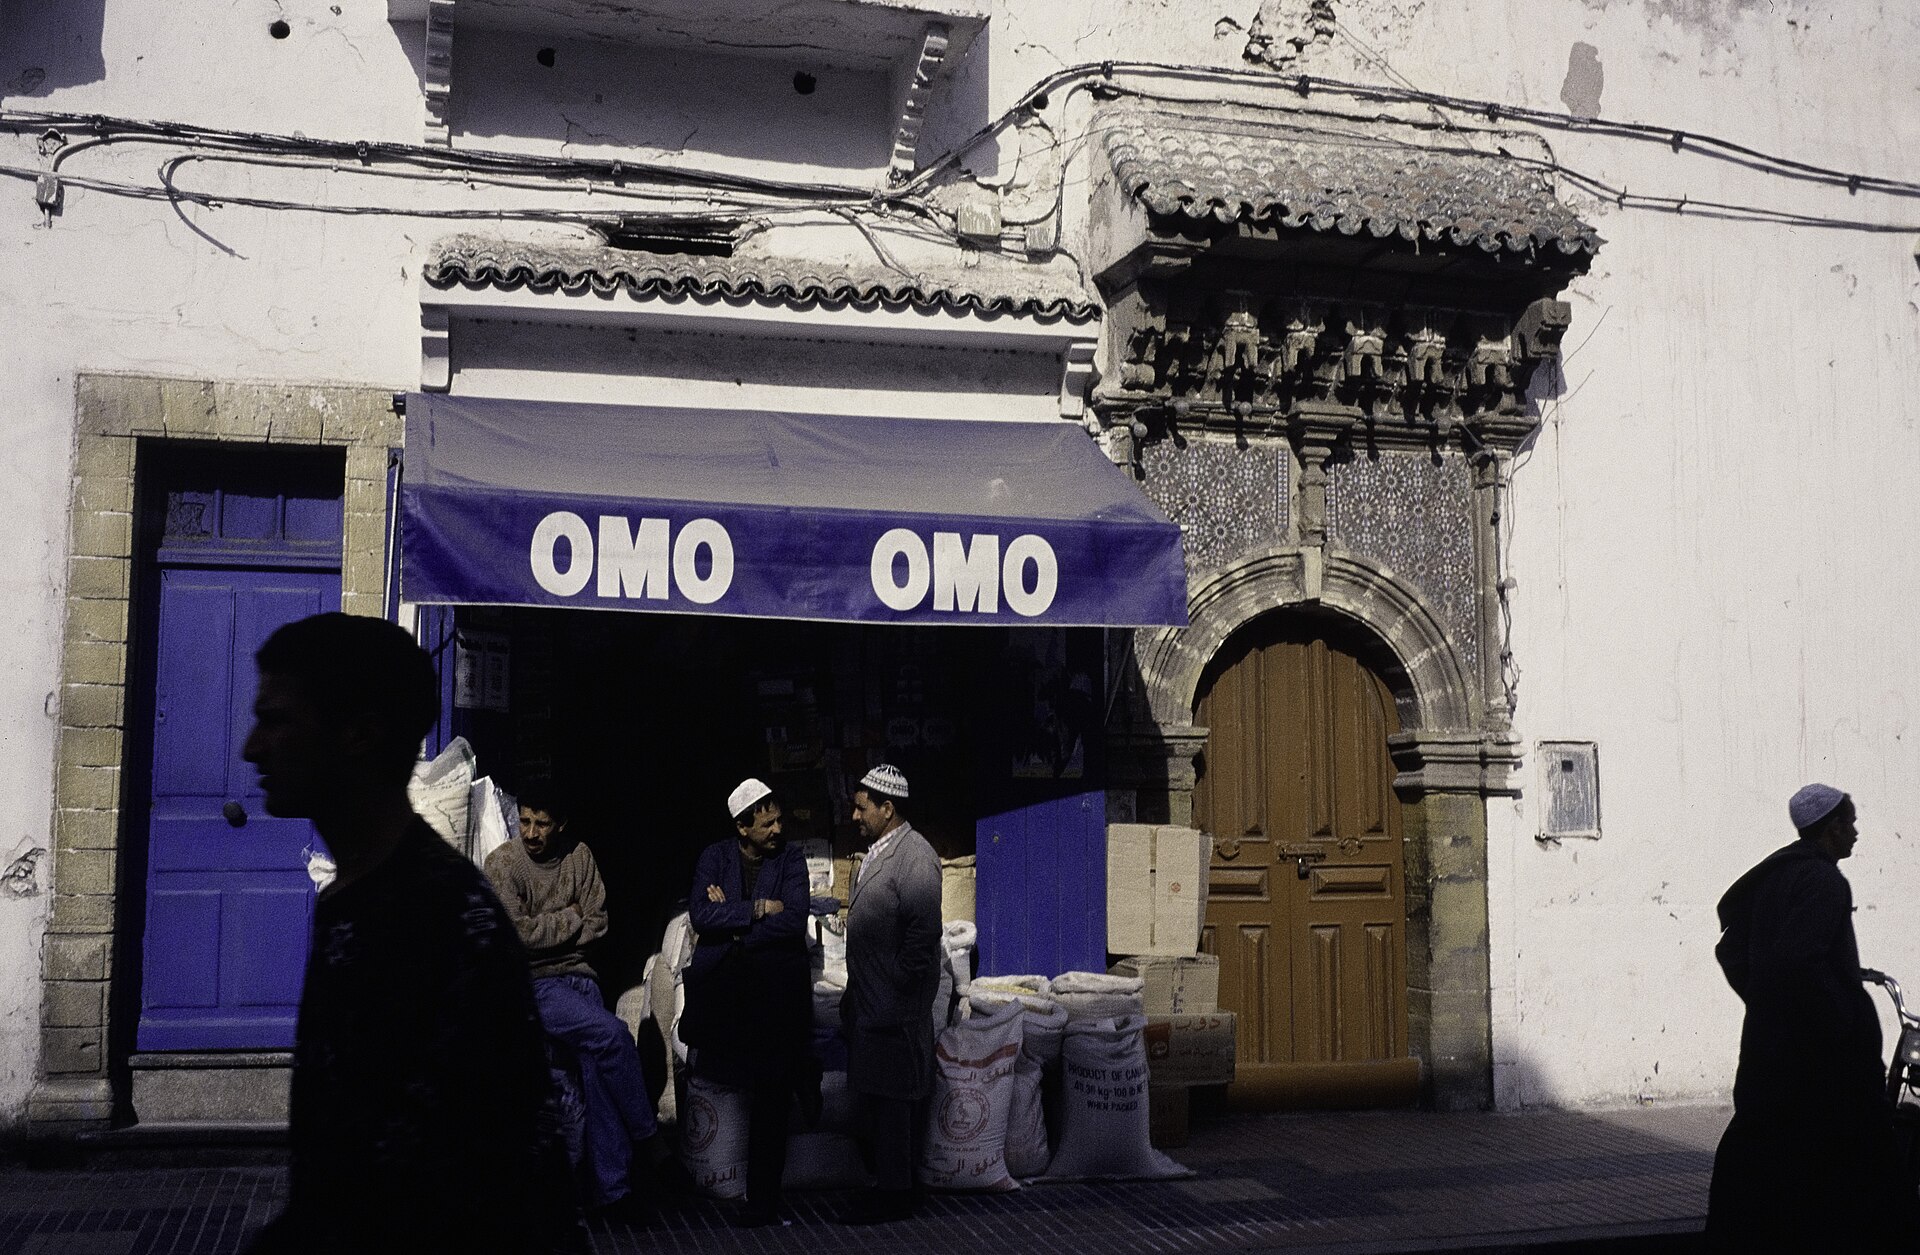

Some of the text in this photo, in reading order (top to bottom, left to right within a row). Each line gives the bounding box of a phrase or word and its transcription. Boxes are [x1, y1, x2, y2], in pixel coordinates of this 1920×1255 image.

[530, 511, 1059, 617] OMO OMO
[1068, 1063, 1107, 1081] PRODUCT
[1111, 1070, 1122, 1081] OF
[1087, 1101, 1138, 1113] WHEN PACKED
